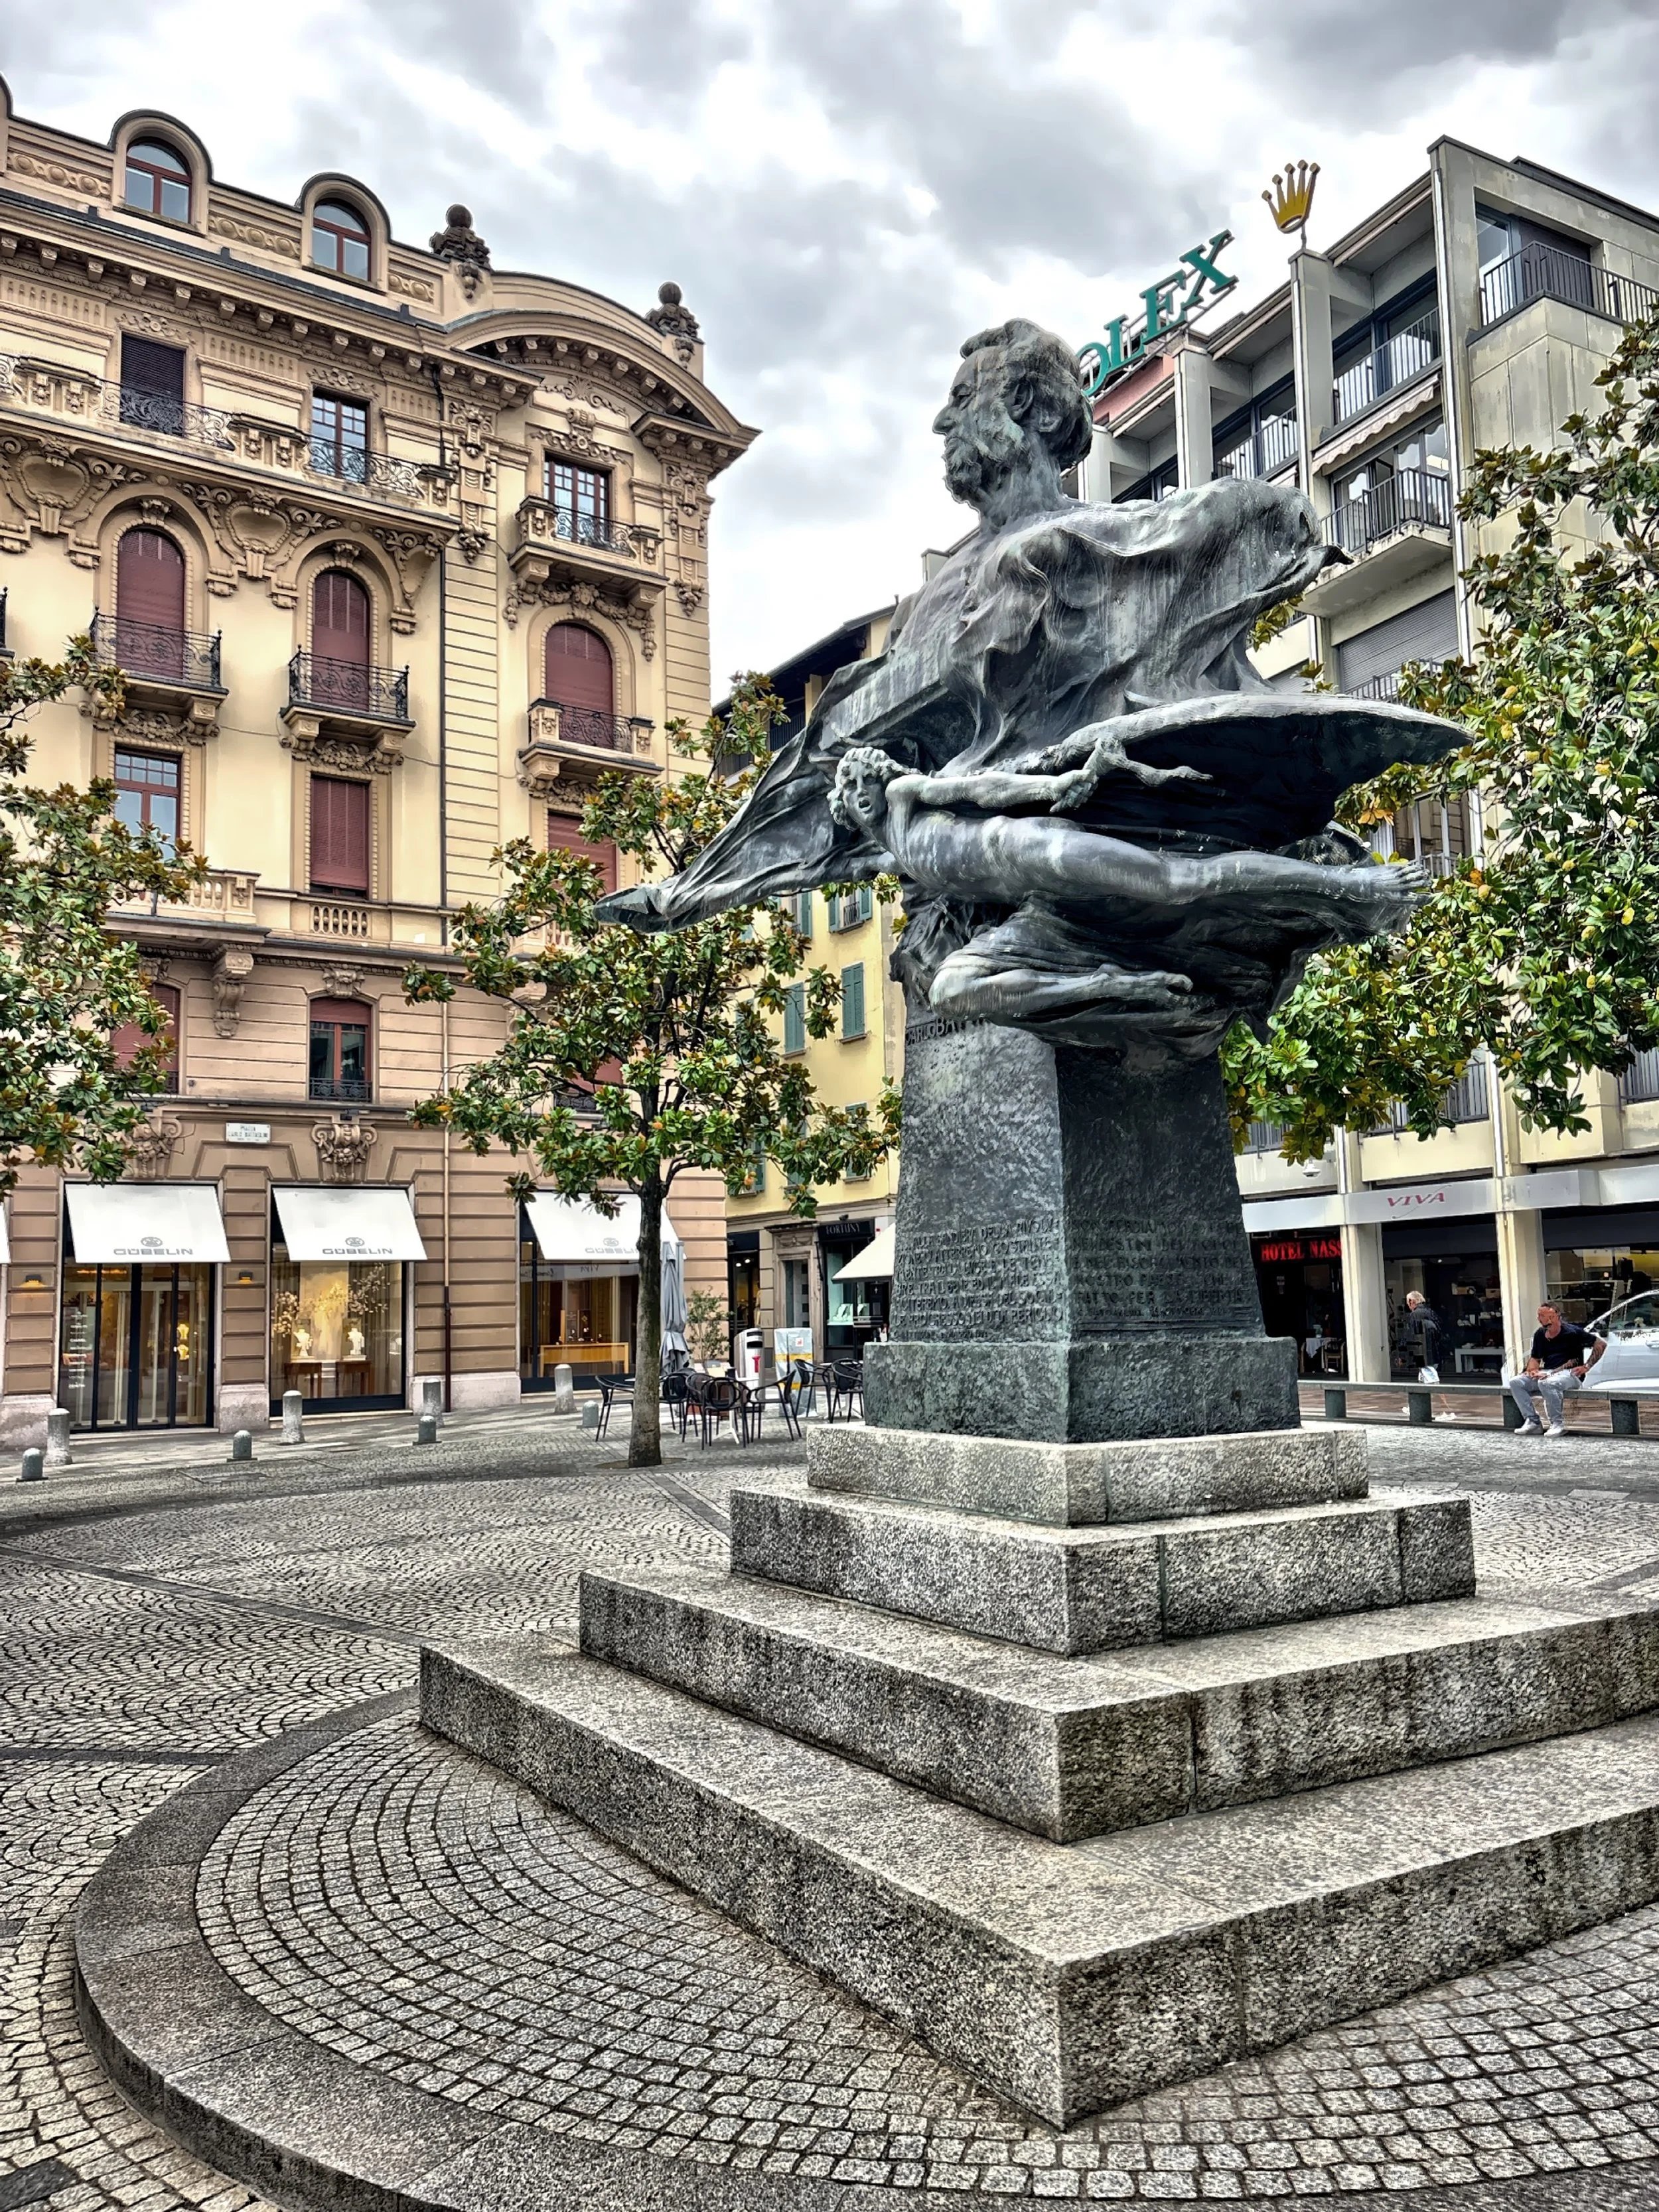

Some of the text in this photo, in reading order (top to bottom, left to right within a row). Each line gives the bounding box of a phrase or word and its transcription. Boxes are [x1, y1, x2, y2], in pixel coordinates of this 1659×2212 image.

[1076, 228, 1239, 397] OLEX
[1387, 1192, 1445, 1207] VIVA
[1261, 1242, 1305, 1261] HOTEL
